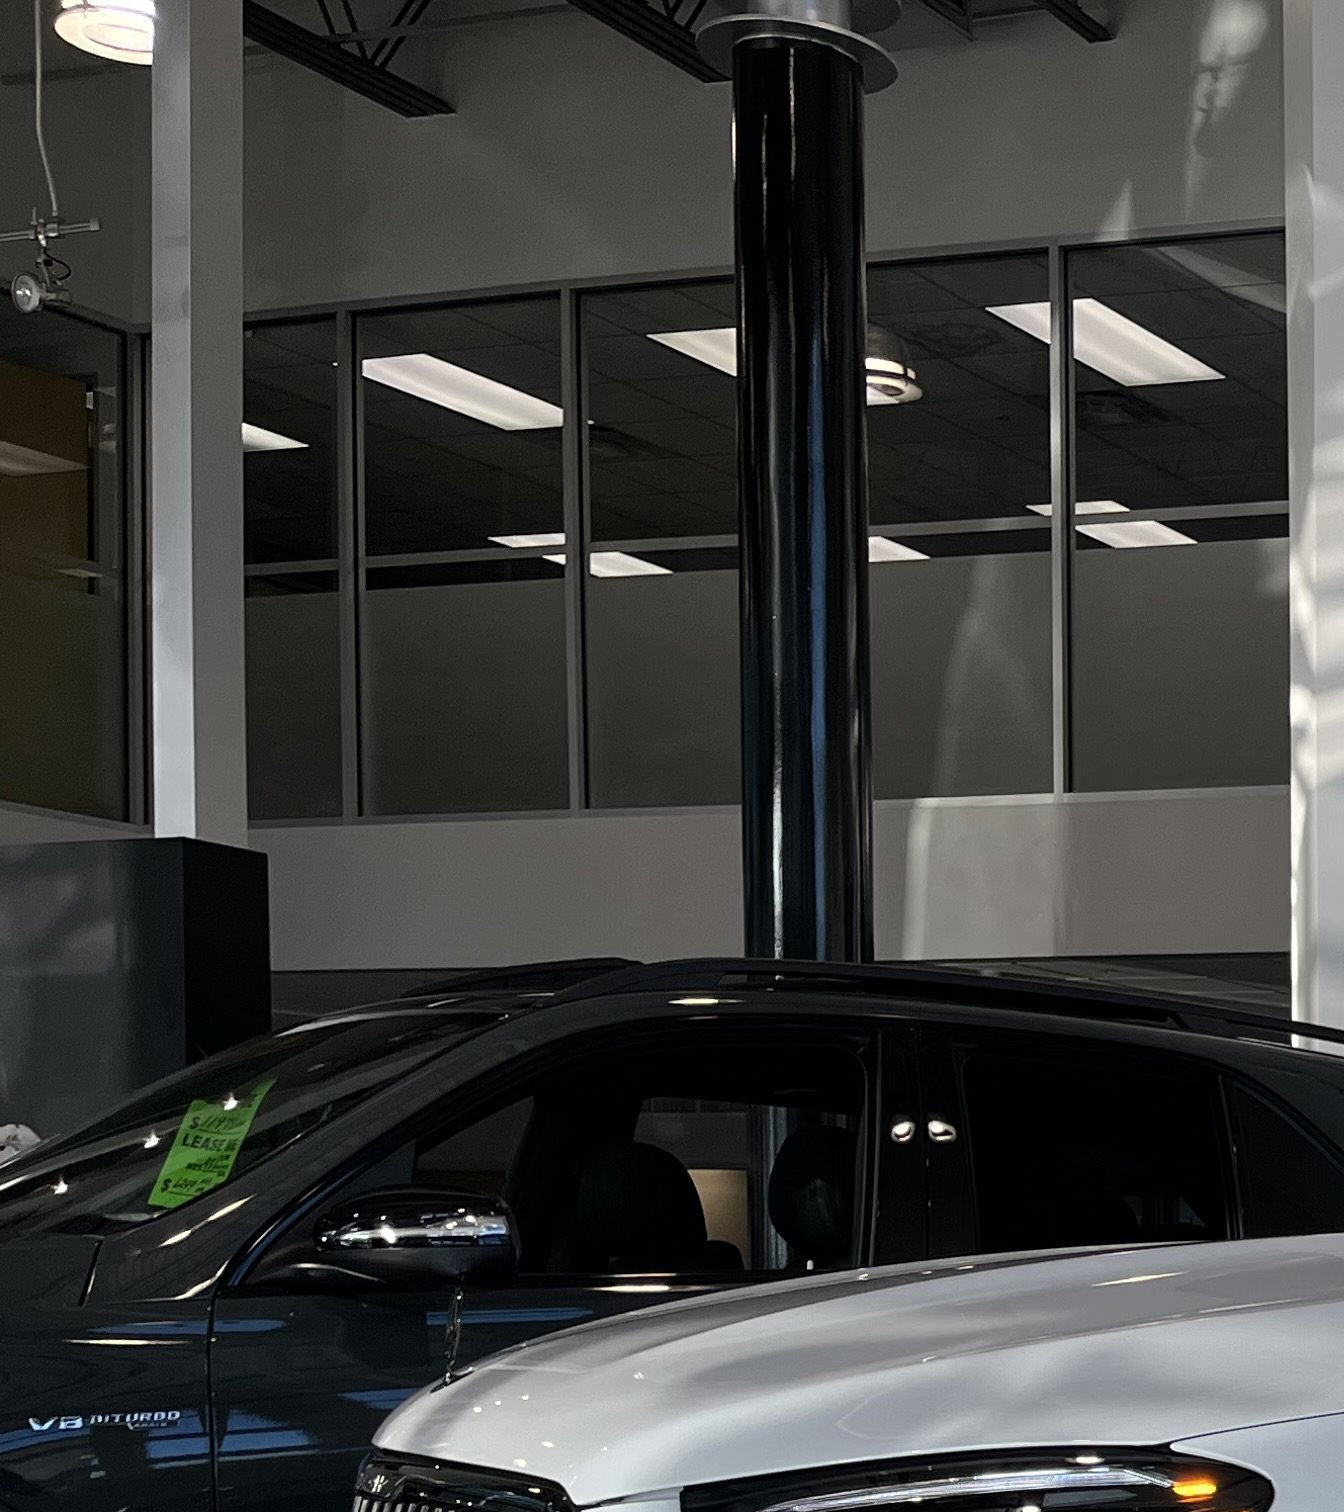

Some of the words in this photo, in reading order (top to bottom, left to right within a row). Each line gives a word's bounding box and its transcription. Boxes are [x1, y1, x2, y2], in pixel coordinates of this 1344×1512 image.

[182, 1133, 226, 1152] LEASE
[28, 1415, 84, 1431] V8
[90, 1410, 181, 1425] BITURBO
